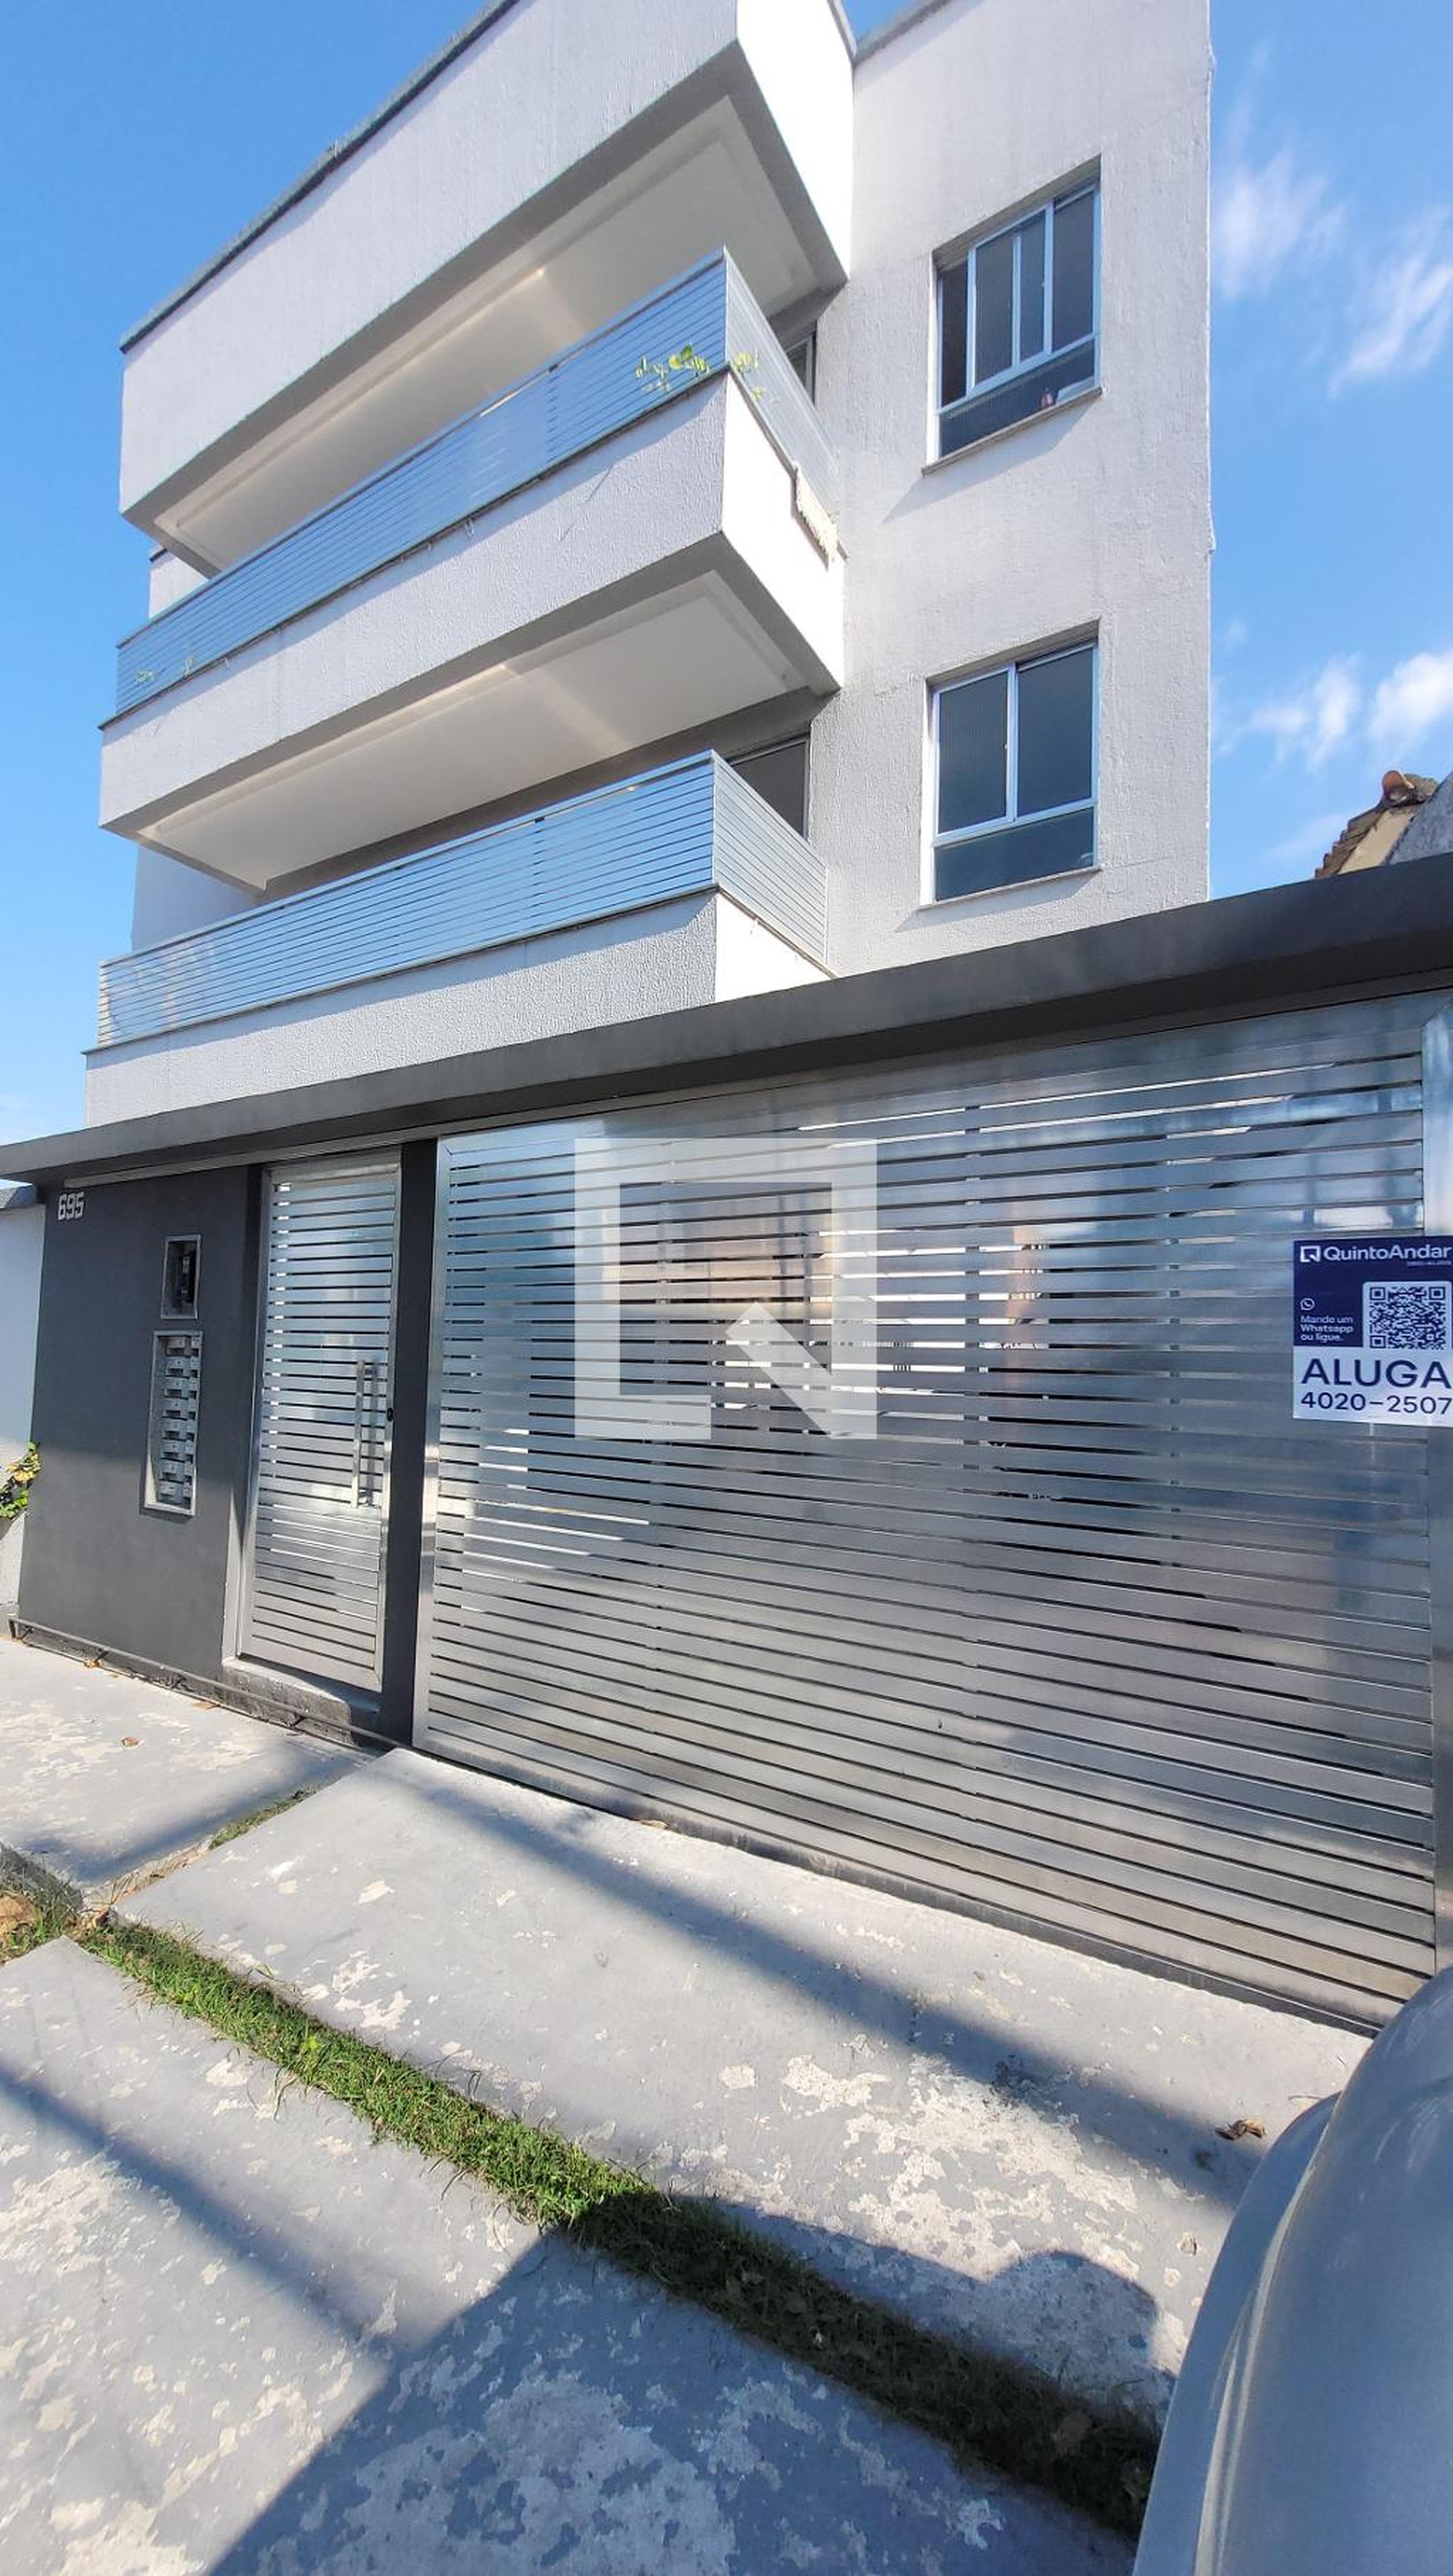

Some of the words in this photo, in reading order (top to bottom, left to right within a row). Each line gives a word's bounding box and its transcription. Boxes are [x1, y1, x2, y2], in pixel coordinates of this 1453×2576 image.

[58, 1192, 84, 1220] 695
[1324, 1244, 1452, 1261] QuintoAndar
[1301, 1358, 1452, 1389] ALUGA
[1301, 1392, 1452, 1415] 4020-2507
